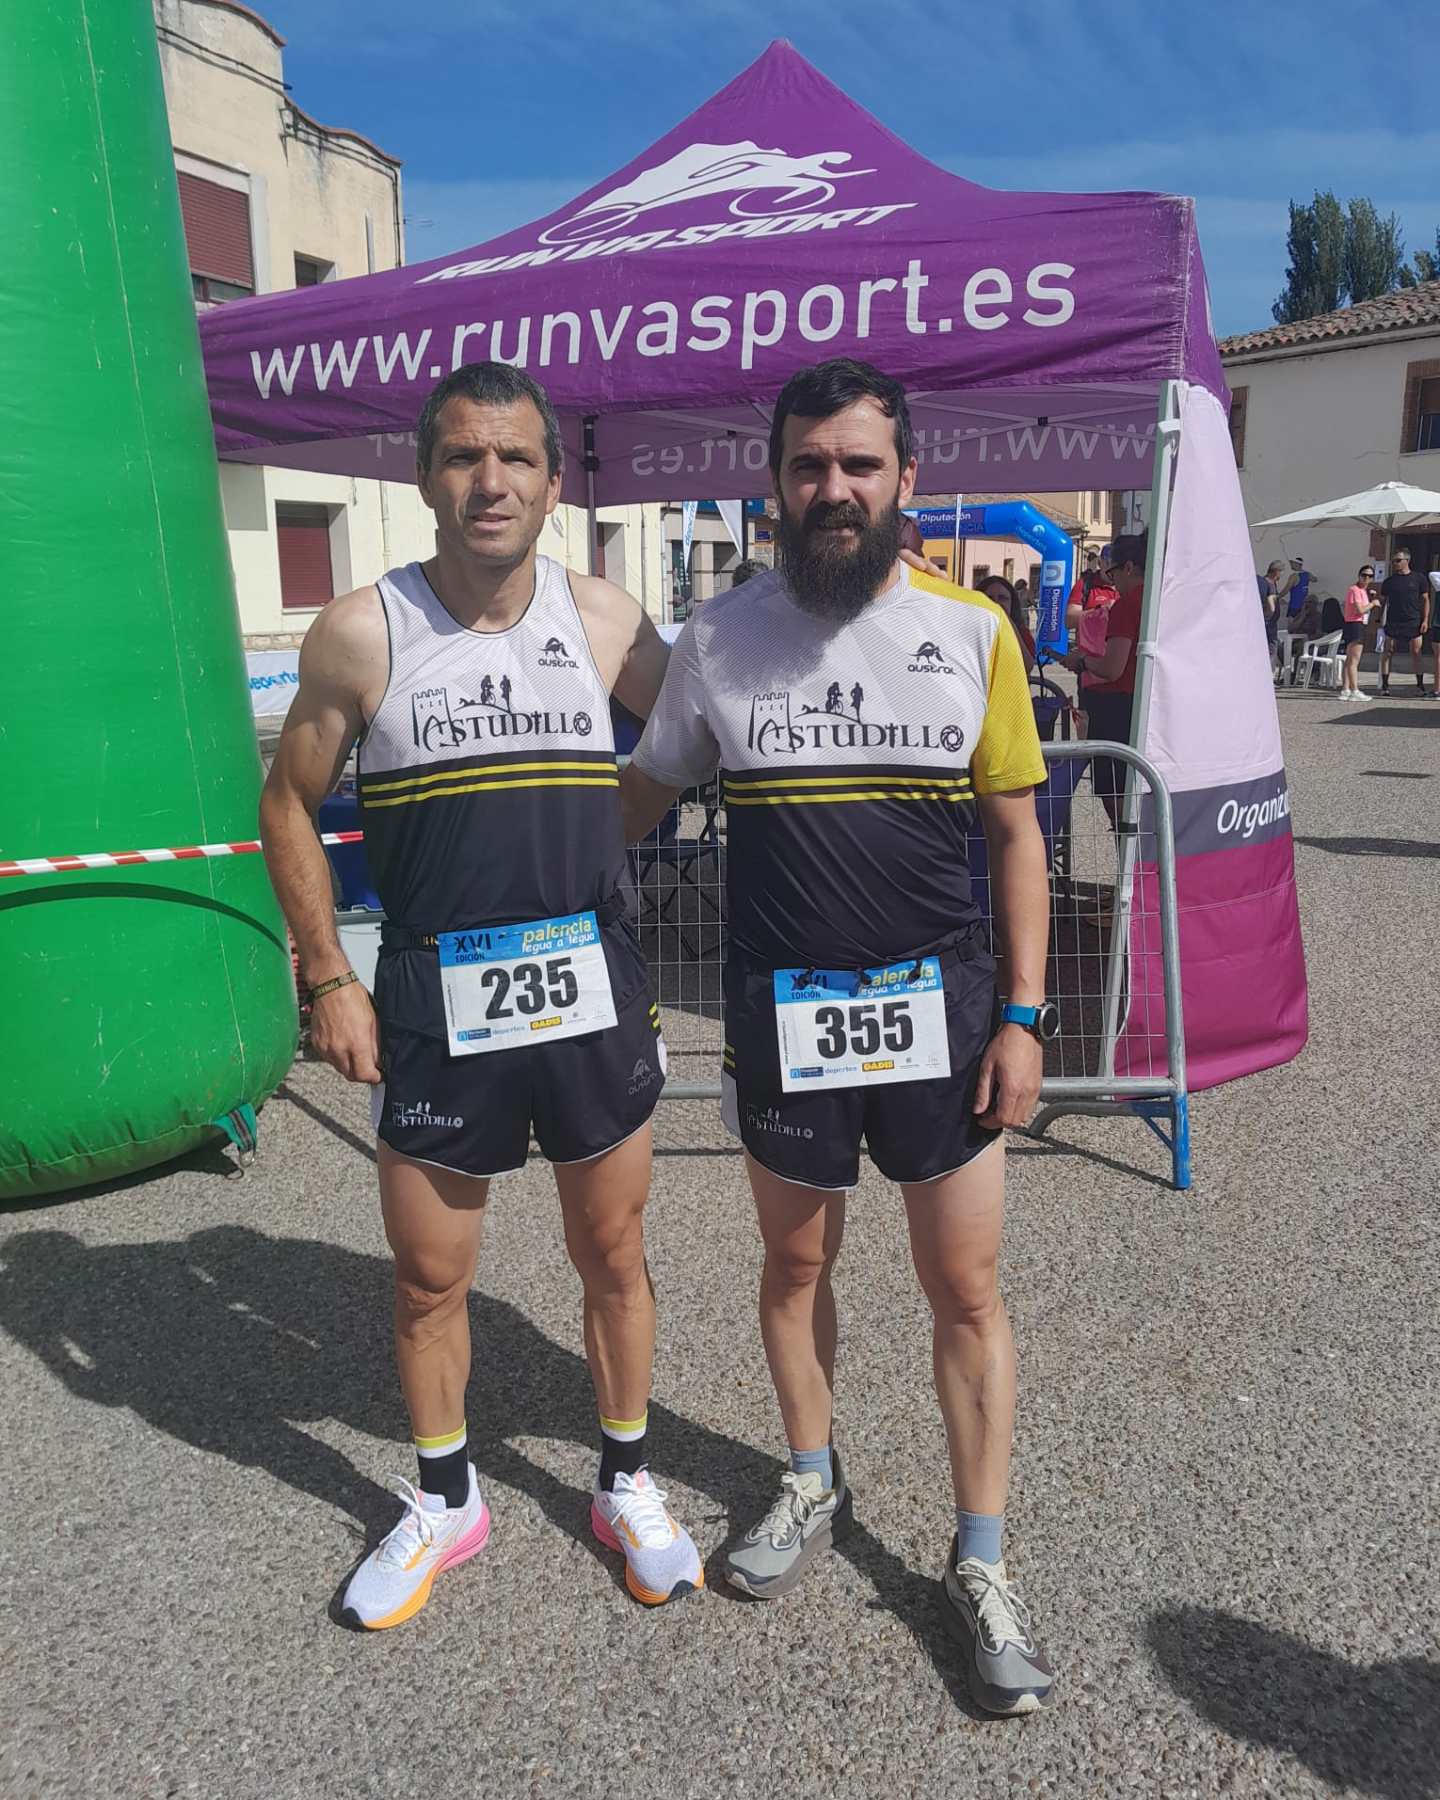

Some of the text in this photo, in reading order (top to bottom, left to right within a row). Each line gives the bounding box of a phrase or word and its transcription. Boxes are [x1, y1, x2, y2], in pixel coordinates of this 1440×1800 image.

[250, 259, 1077, 401] www.runvasport.es
[454, 933, 493, 954] XVI
[523, 917, 592, 944] palencia
[481, 957, 579, 1021] 235
[815, 1000, 914, 1060] 355
